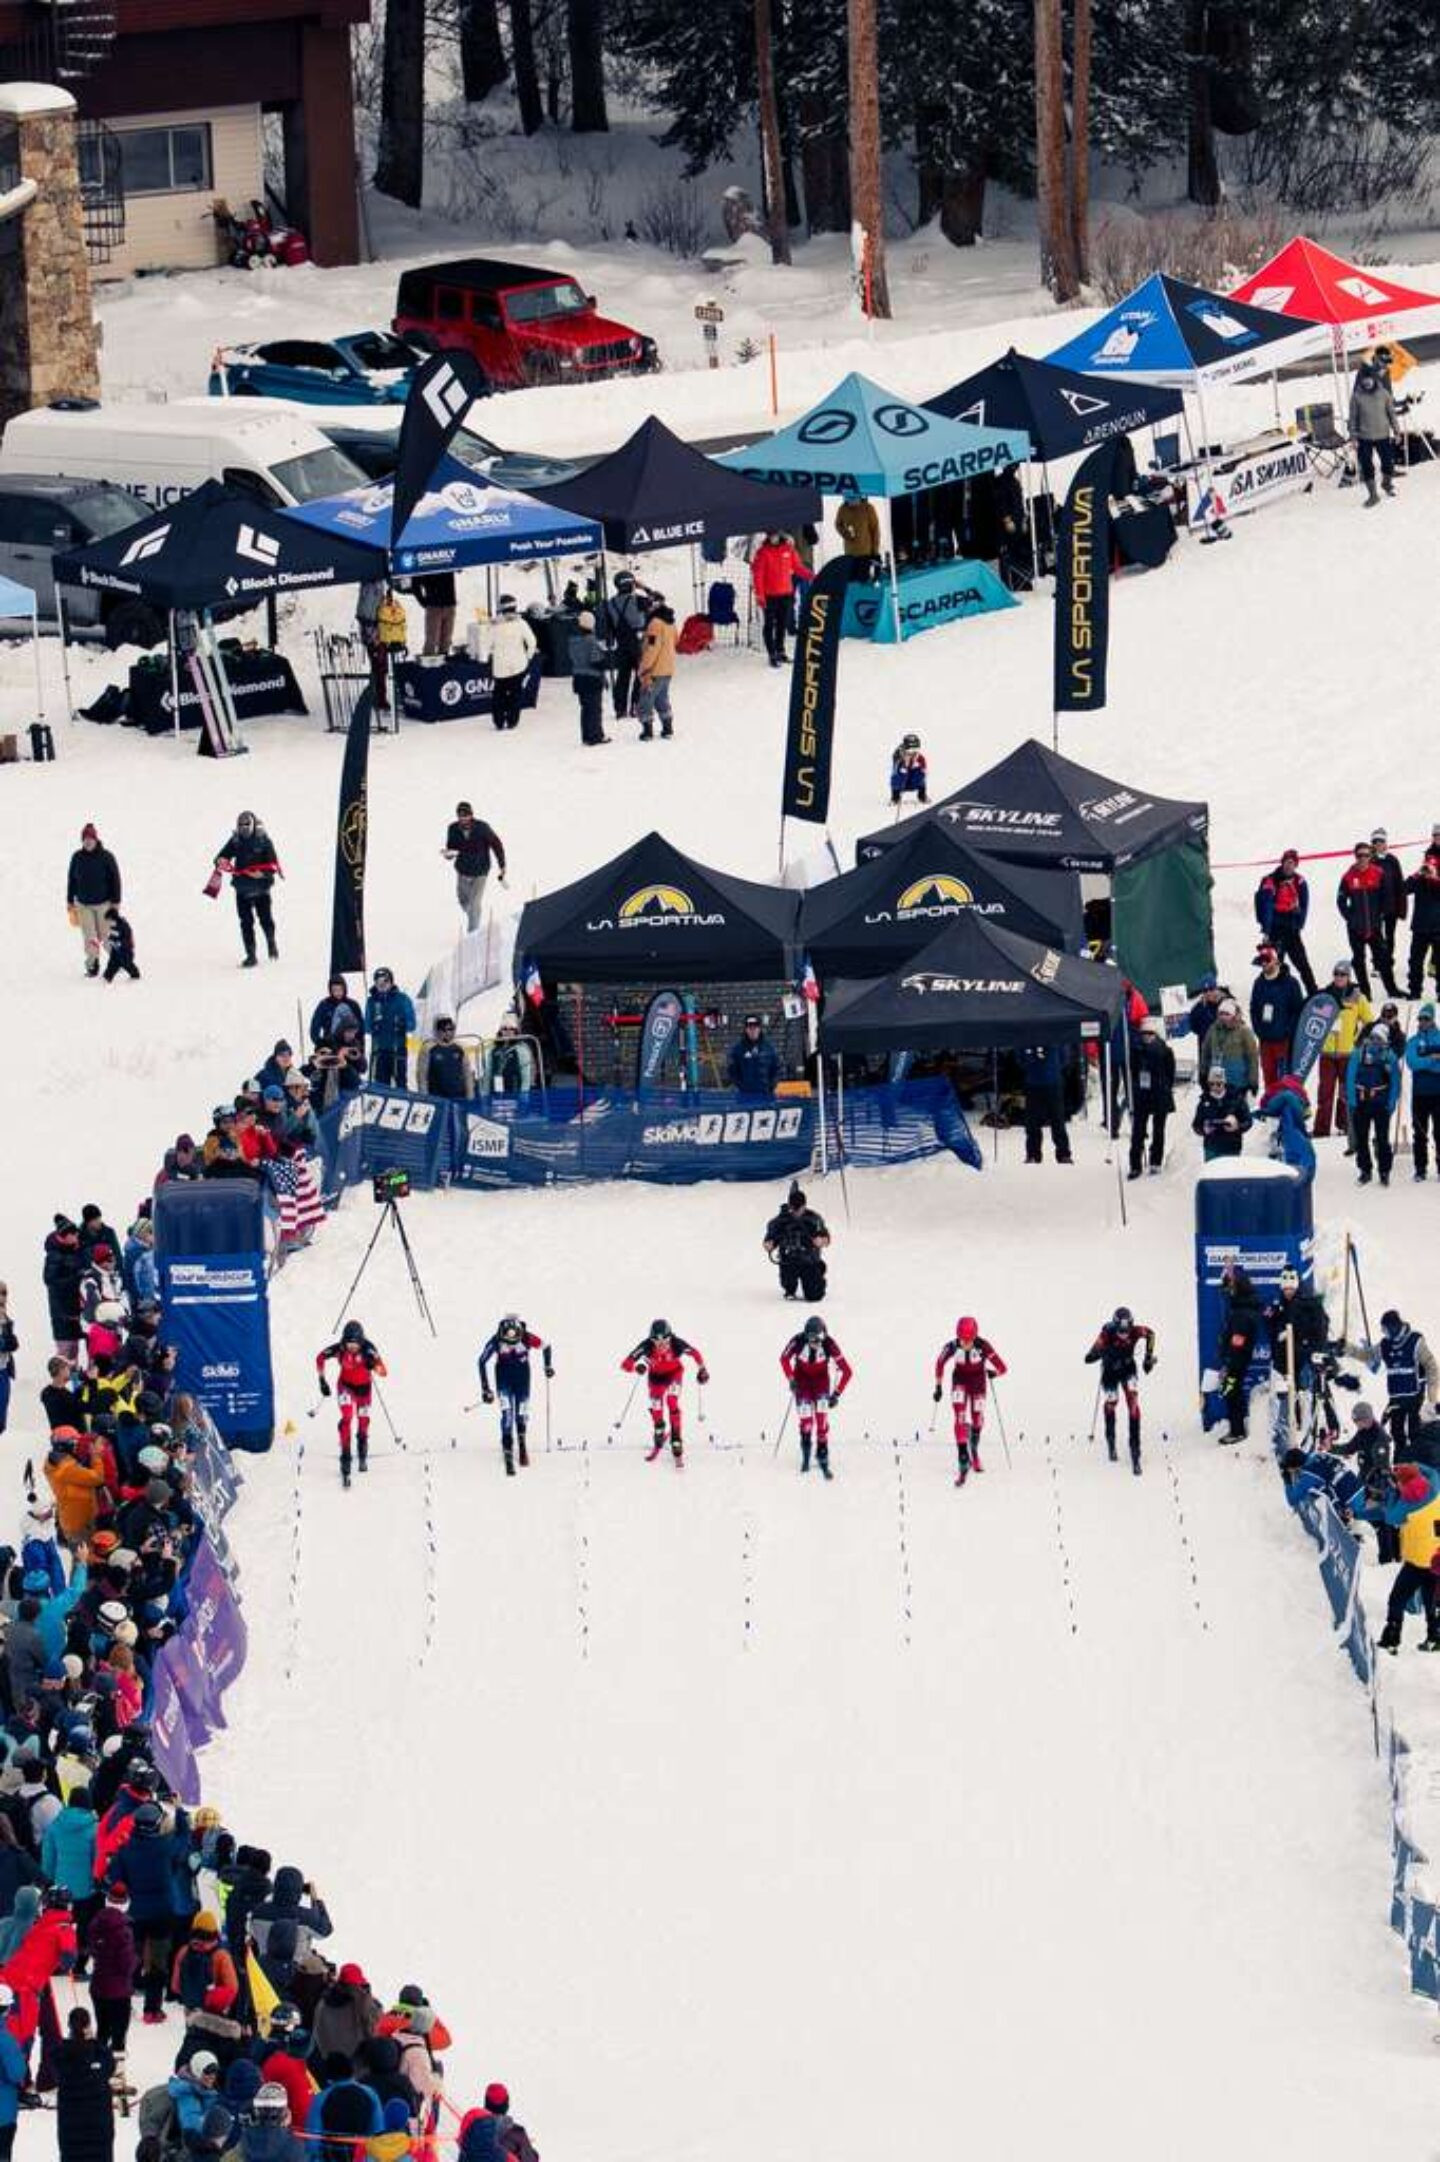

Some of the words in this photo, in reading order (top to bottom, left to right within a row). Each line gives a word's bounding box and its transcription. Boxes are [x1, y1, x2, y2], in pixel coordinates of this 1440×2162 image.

[903, 441, 1013, 490] SCARPA
[652, 524, 683, 541] BLUE
[684, 520, 705, 536] ICE
[241, 574, 277, 591] Black
[278, 567, 335, 586] Diamond
[1071, 486, 1095, 650] SPORTIVA
[800, 594, 829, 760] SPORTIVA
[1072, 658, 1093, 698] LA
[796, 766, 816, 808] LA
[965, 808, 1063, 826] SKYLINE
[586, 920, 614, 930] LA
[618, 913, 726, 928] SPORTIVA
[865, 911, 892, 923] LA
[930, 979, 1026, 994] SKYLINE
